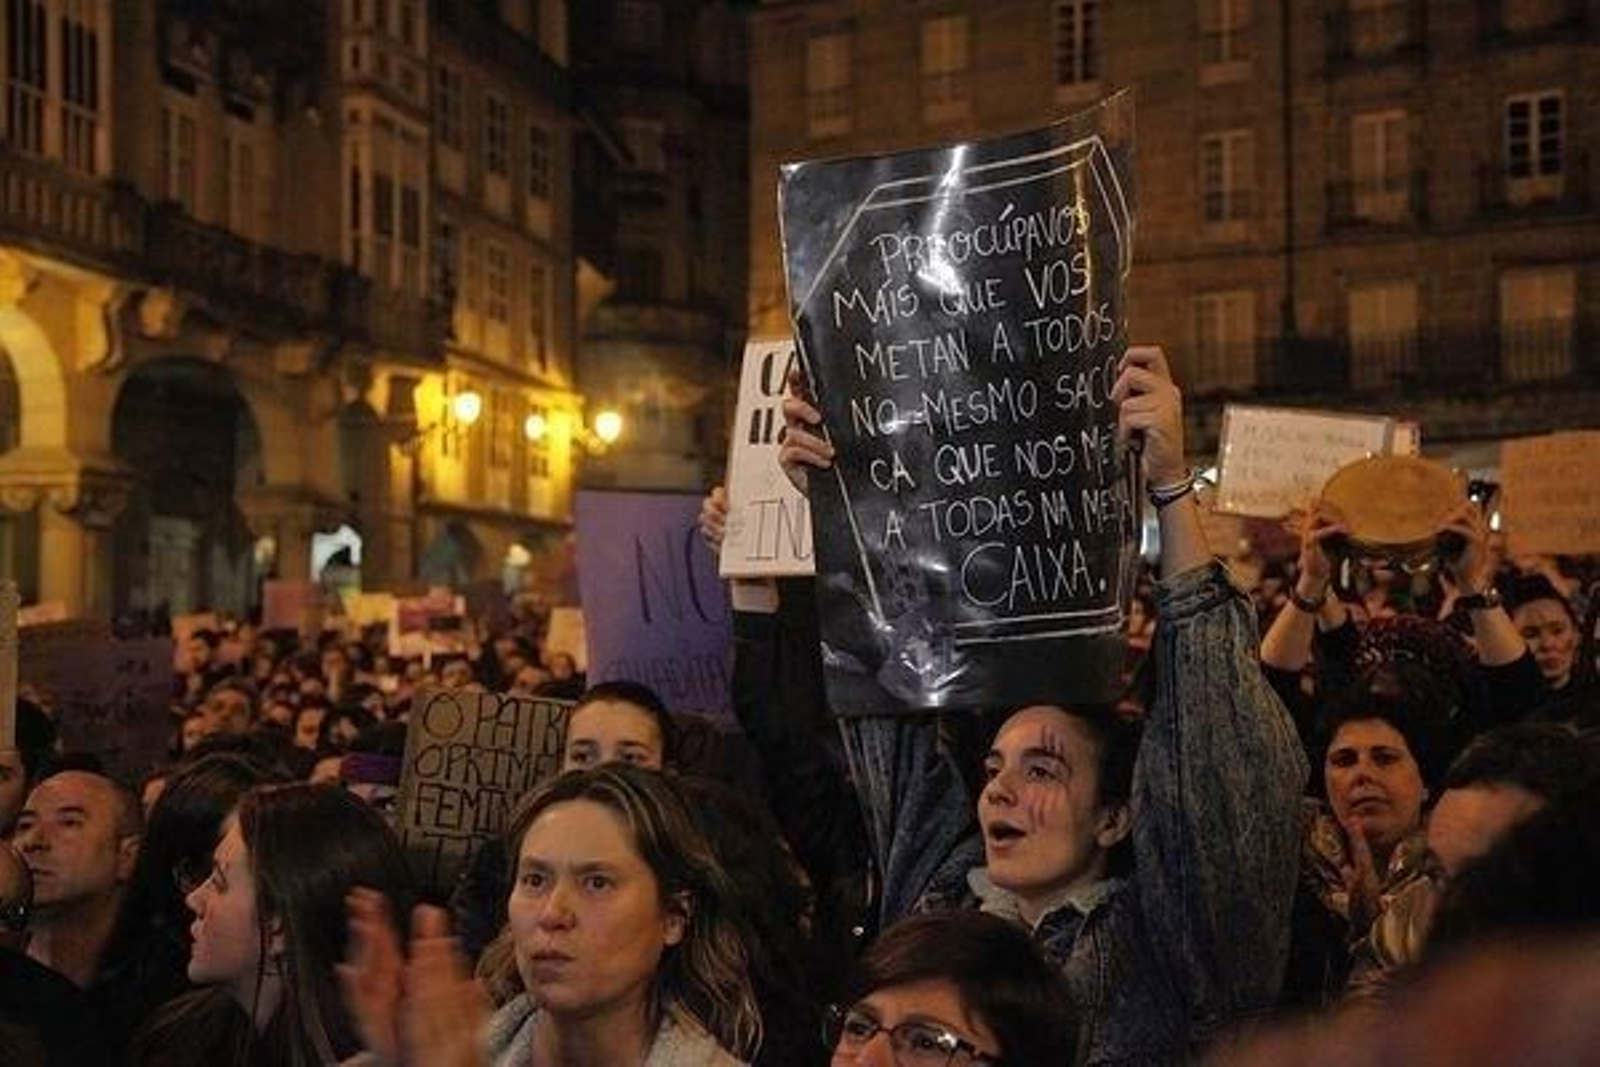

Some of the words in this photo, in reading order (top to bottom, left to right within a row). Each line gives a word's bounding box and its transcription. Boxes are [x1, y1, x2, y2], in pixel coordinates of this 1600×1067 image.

[833, 278, 918, 328] MÁIS
[939, 278, 1006, 316] QUE
[1024, 250, 1091, 310] VOS
[854, 325, 970, 383] METAN
[991, 321, 1015, 364] A
[1024, 301, 1115, 358] TODOS
[850, 398, 898, 438] NO
[921, 377, 1038, 437] MESMO
[870, 450, 916, 493] CA
[934, 443, 1003, 486] QUE
[1015, 434, 1075, 480] NOS
[884, 509, 907, 551] A
[919, 490, 1034, 542] TODAS
[1040, 489, 1074, 539] NA
[961, 540, 1107, 611] CAIXA.
[423, 692, 464, 741] O
